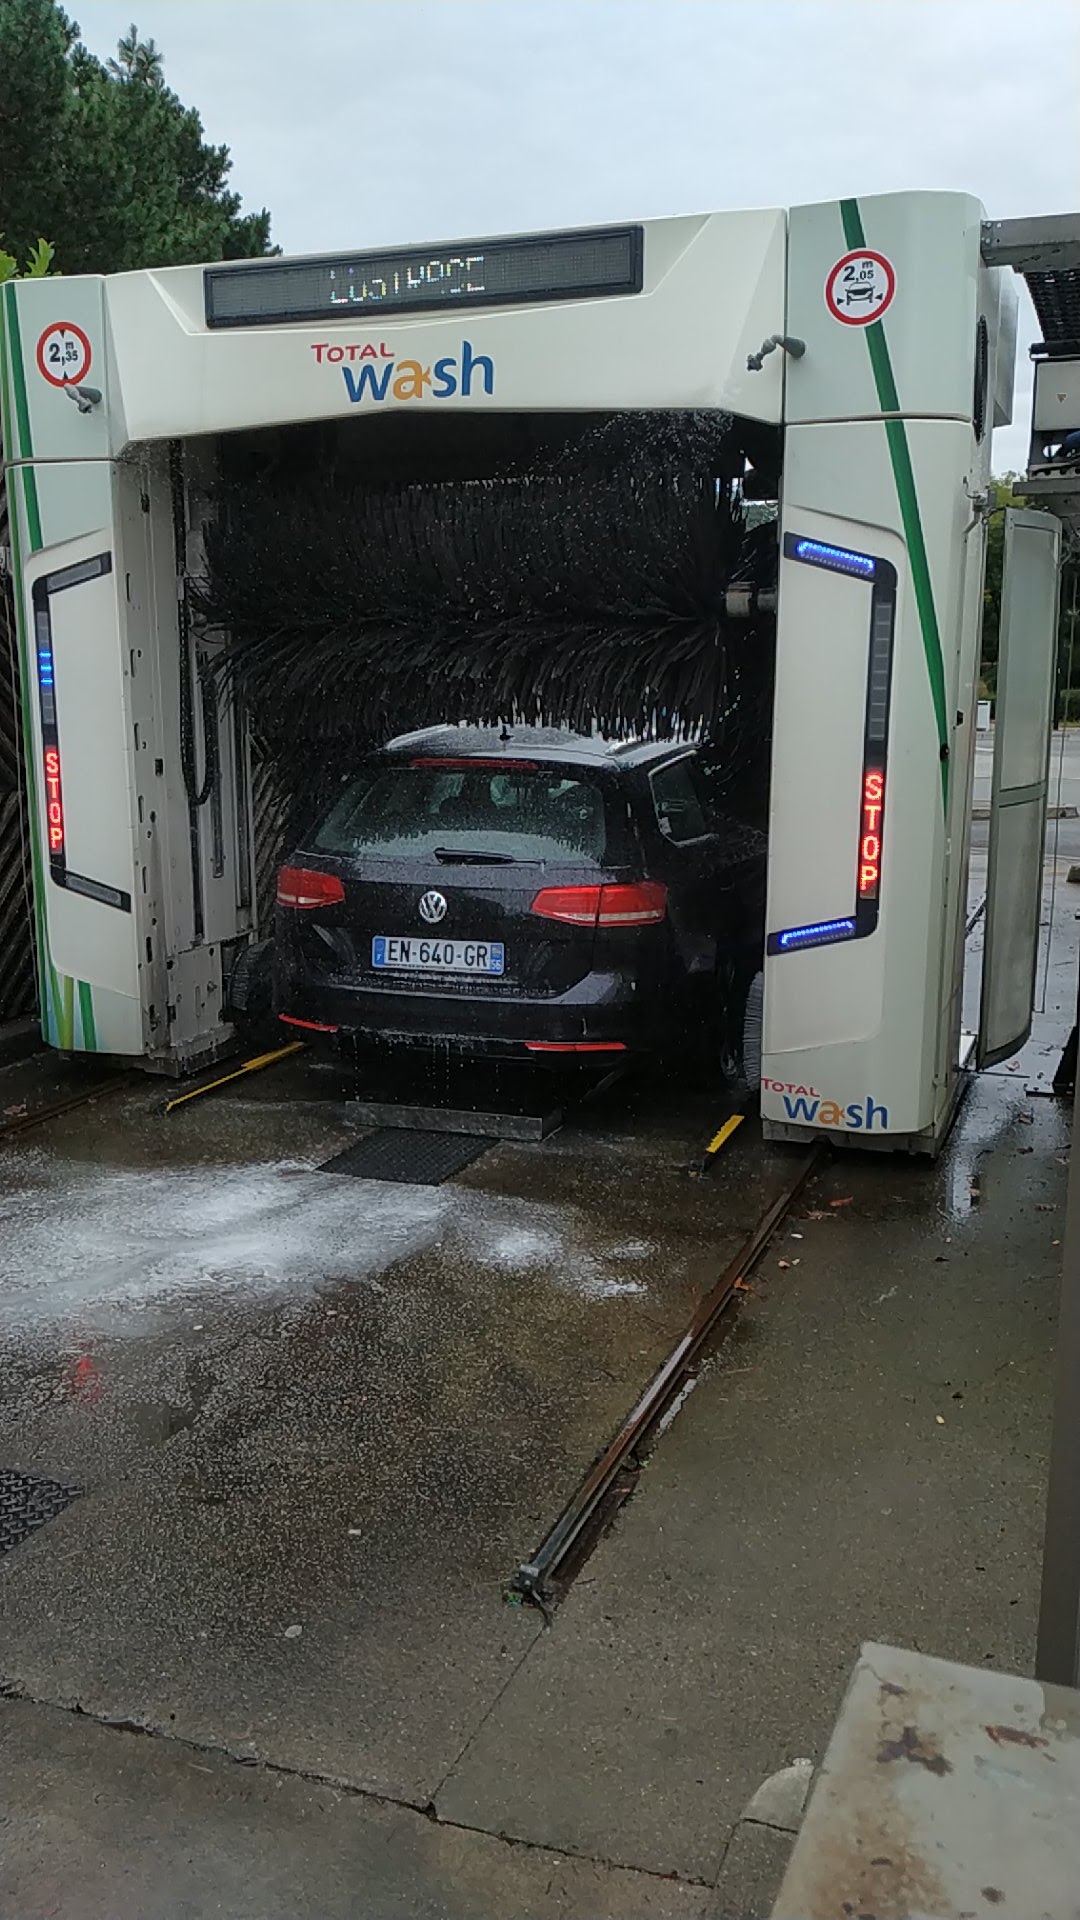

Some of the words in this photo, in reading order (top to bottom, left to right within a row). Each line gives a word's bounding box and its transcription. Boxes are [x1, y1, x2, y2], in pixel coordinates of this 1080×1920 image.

[310, 342, 395, 364] TOTAL
[46, 752, 63, 849] STOP
[860, 774, 884, 891] STOP
[760, 1077, 821, 1098] TOTAL
